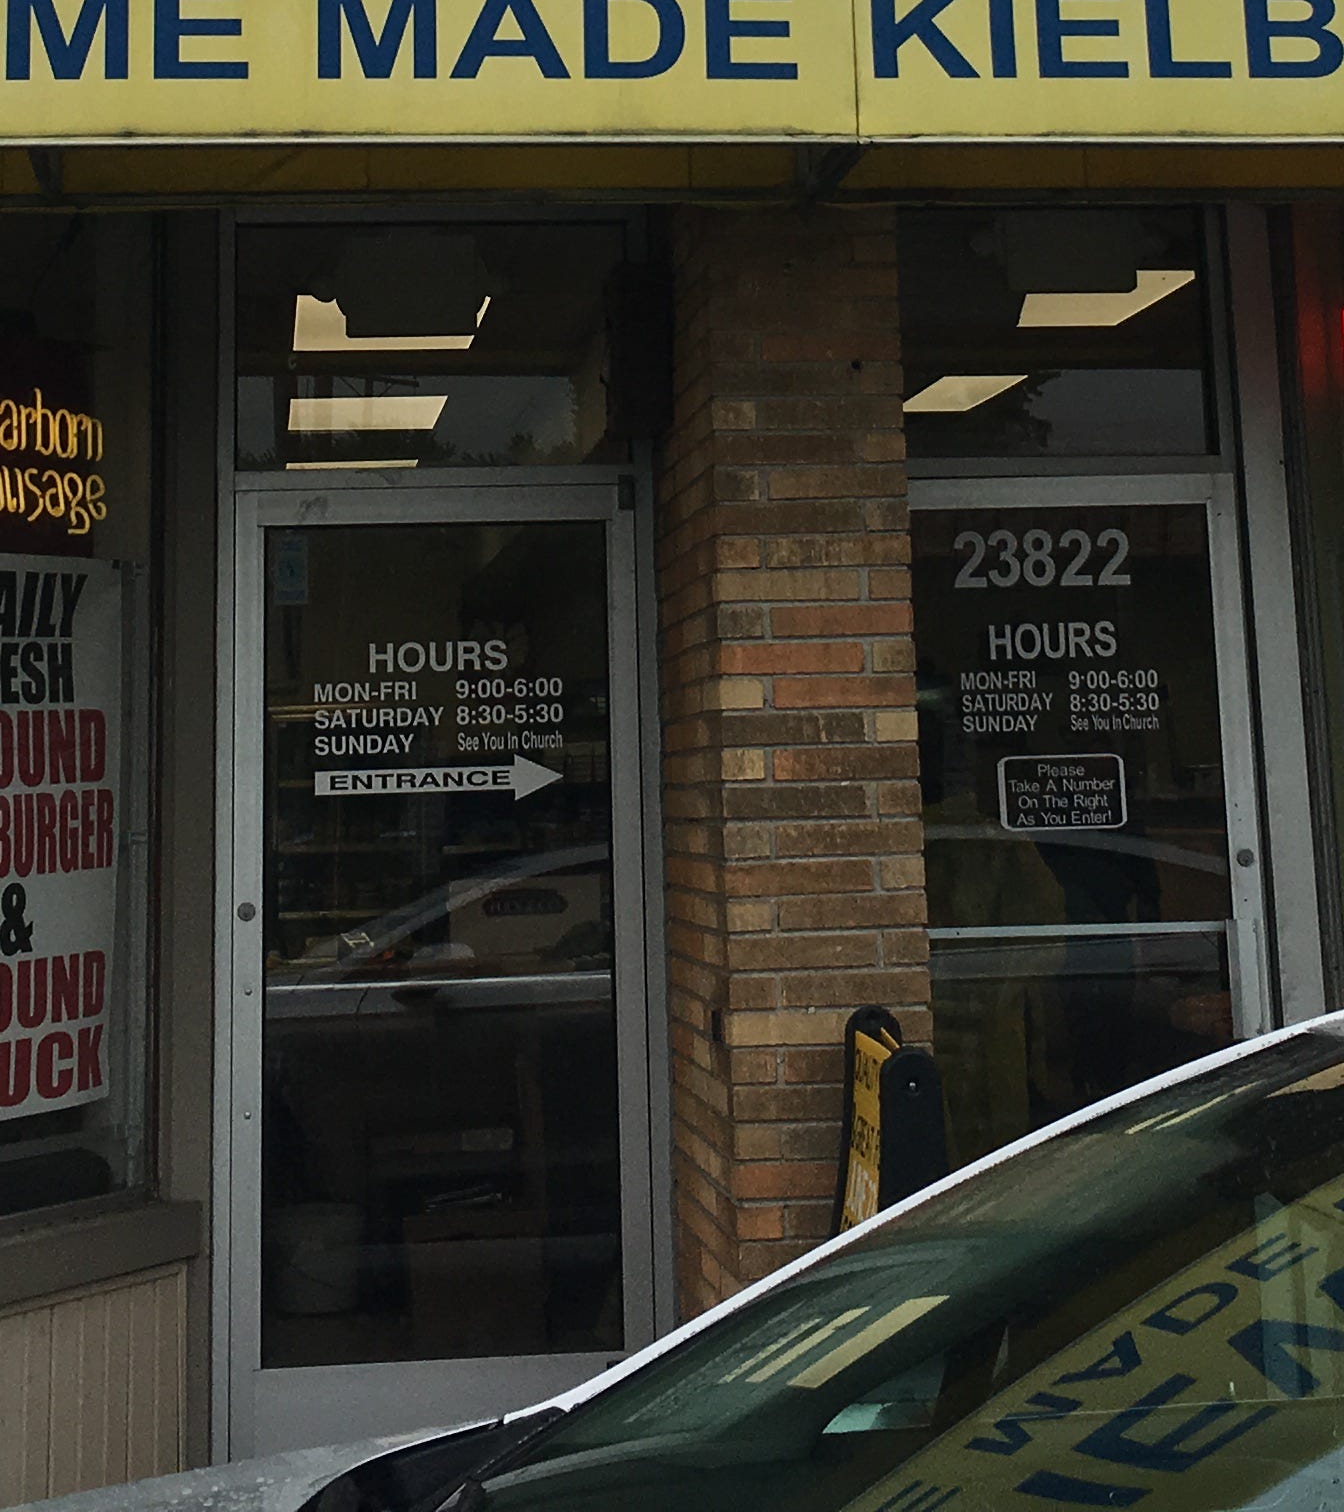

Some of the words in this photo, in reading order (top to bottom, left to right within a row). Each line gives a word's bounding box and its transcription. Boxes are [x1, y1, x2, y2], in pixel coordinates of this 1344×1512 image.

[953, 528, 1131, 588] 23822
[988, 620, 1117, 661] HOURS
[368, 640, 508, 674] HOURS
[314, 681, 417, 703] MON-FRI
[455, 677, 563, 699] 9:00-6:00
[960, 670, 1036, 690] MON-FRI
[962, 692, 1053, 712] SATURDAY
[1069, 692, 1160, 712] 8:30-5:30
[314, 706, 444, 729] SATURDAY
[455, 703, 564, 725] 8:30-5:30
[962, 714, 1038, 733] SUNDAY
[1070, 714, 1089, 731] See
[1091, 714, 1111, 731] You
[1122, 713, 1160, 730] Church
[314, 733, 414, 756] SUNDAY
[457, 732, 480, 751] See
[482, 731, 504, 750] You
[507, 730, 519, 749] In
[521, 730, 564, 749] Church
[329, 769, 511, 791] ENTRANCE
[1037, 763, 1086, 778] Please
[1009, 780, 1040, 794] Take
[1046, 779, 1057, 792] A
[1062, 778, 1115, 792] Number
[1018, 795, 1039, 809] On
[1043, 795, 1069, 809] The
[1073, 793, 1109, 811] Right
[1016, 812, 1036, 826] As
[1040, 811, 1067, 826] You
[0, 882, 34, 956] &
